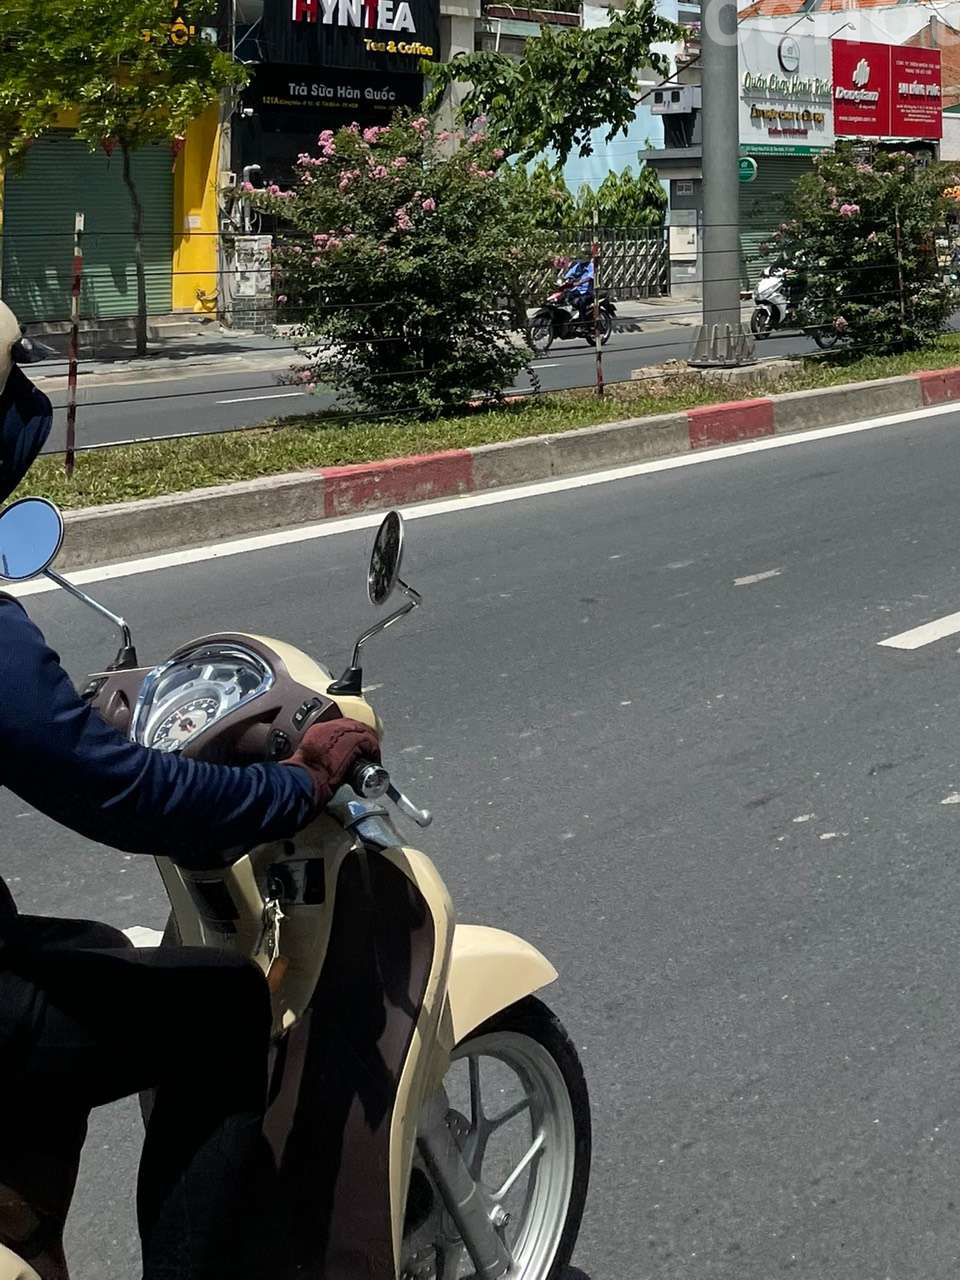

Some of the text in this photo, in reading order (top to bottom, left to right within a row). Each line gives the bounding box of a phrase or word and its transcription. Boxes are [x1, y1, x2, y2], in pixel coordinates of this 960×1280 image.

[364, 39, 433, 56] Tea & Coffee
[288, 82, 396, 100] Trà Sữa Hàn Quốc
